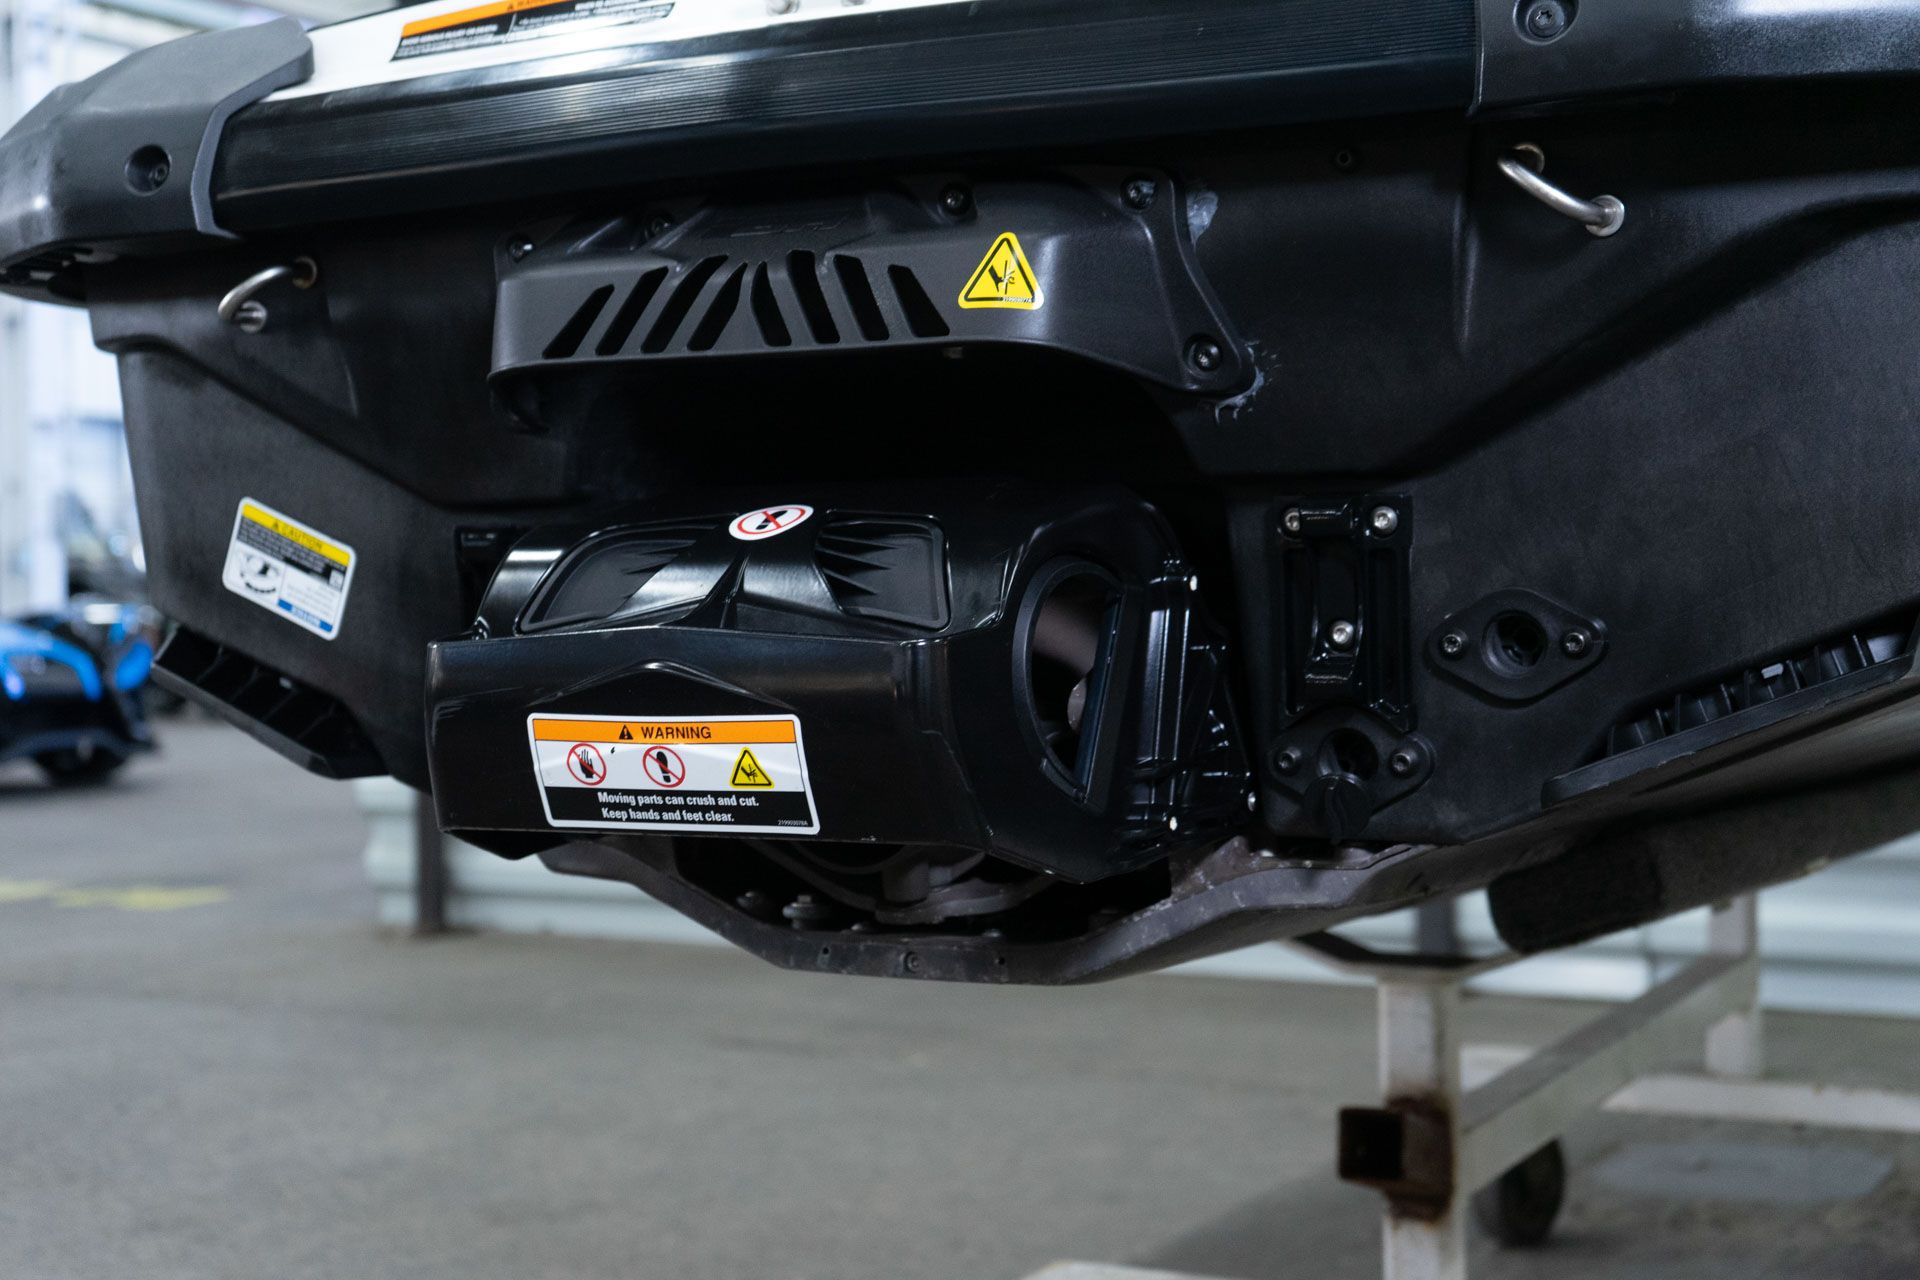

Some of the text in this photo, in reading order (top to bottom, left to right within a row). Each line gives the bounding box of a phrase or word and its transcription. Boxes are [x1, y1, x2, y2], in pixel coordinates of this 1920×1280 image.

[641, 726, 712, 739] WARNING
[597, 791, 760, 806] Moving parts can crush and cut.
[602, 807, 735, 822] Keep hands and feet clear.
